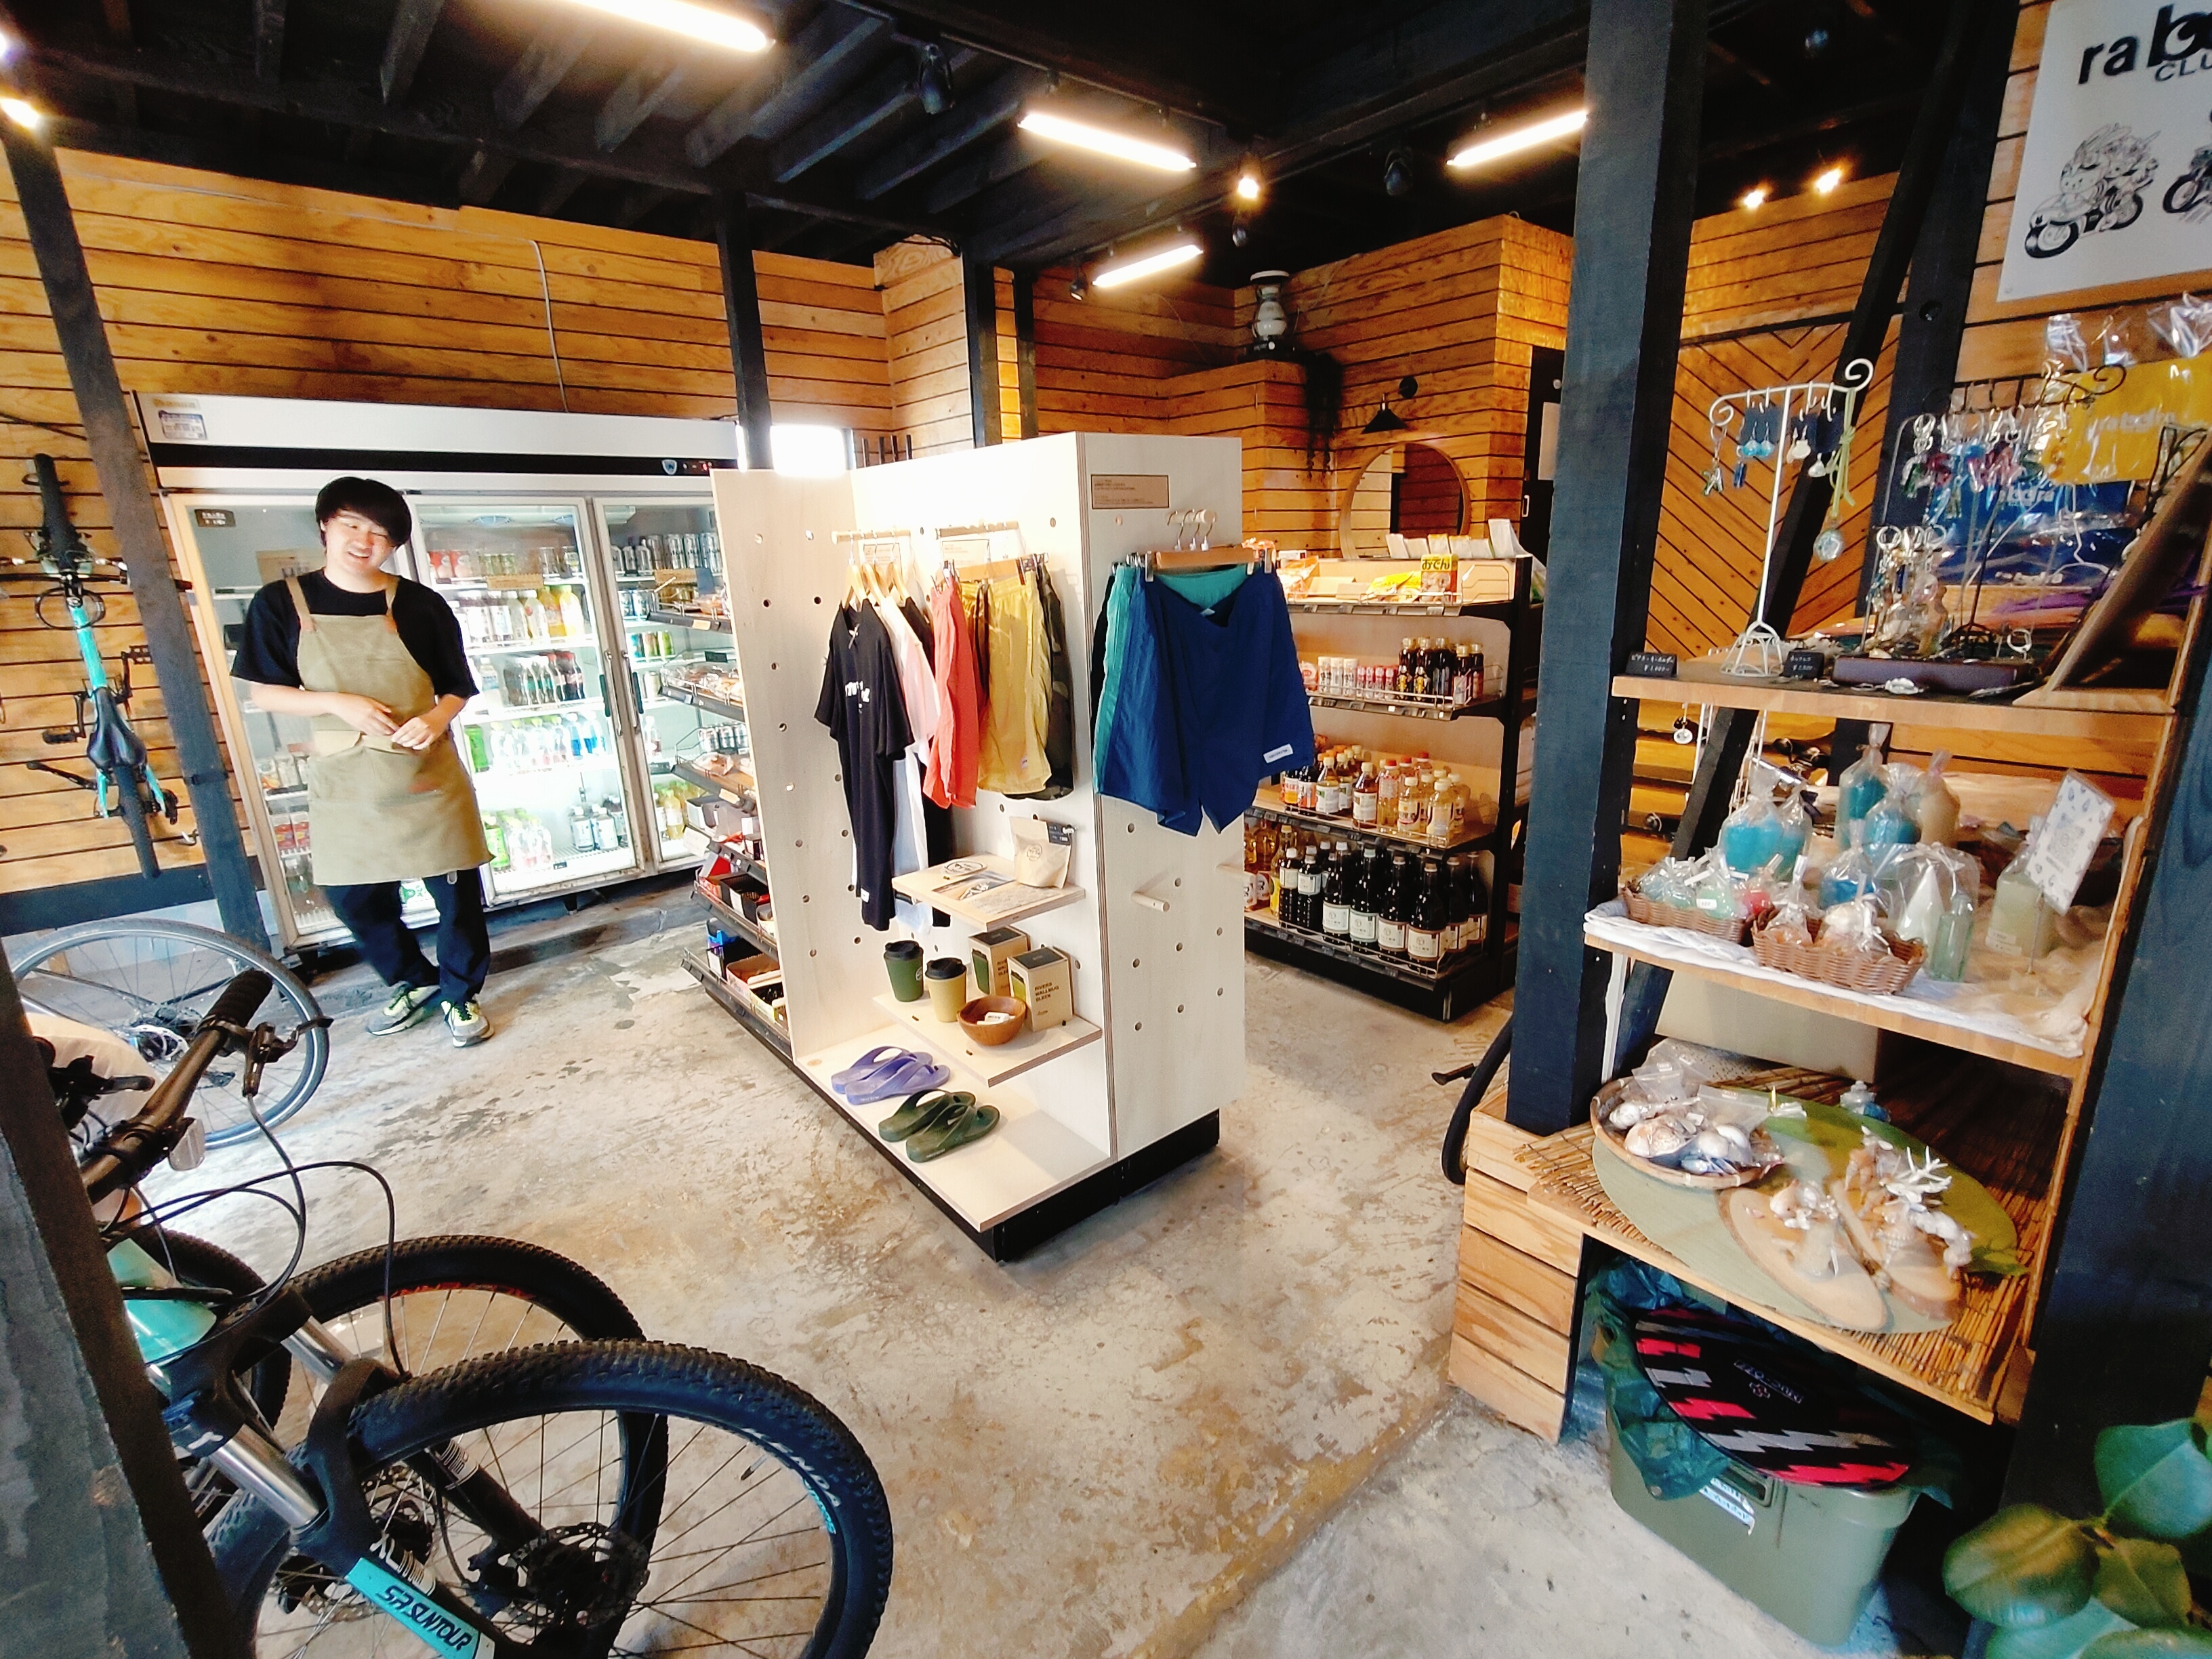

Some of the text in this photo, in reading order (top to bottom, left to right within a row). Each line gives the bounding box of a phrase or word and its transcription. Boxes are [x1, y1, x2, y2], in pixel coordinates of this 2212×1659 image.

[2078, 36, 2137, 84] ra
[1422, 557, 1450, 571] おでん
[1034, 981, 1052, 991] RIVERS
[1035, 985, 1059, 997] WALLMUG
[1036, 994, 1051, 1002] SLEEK
[402, 1602, 473, 1652] SUNTOUR
